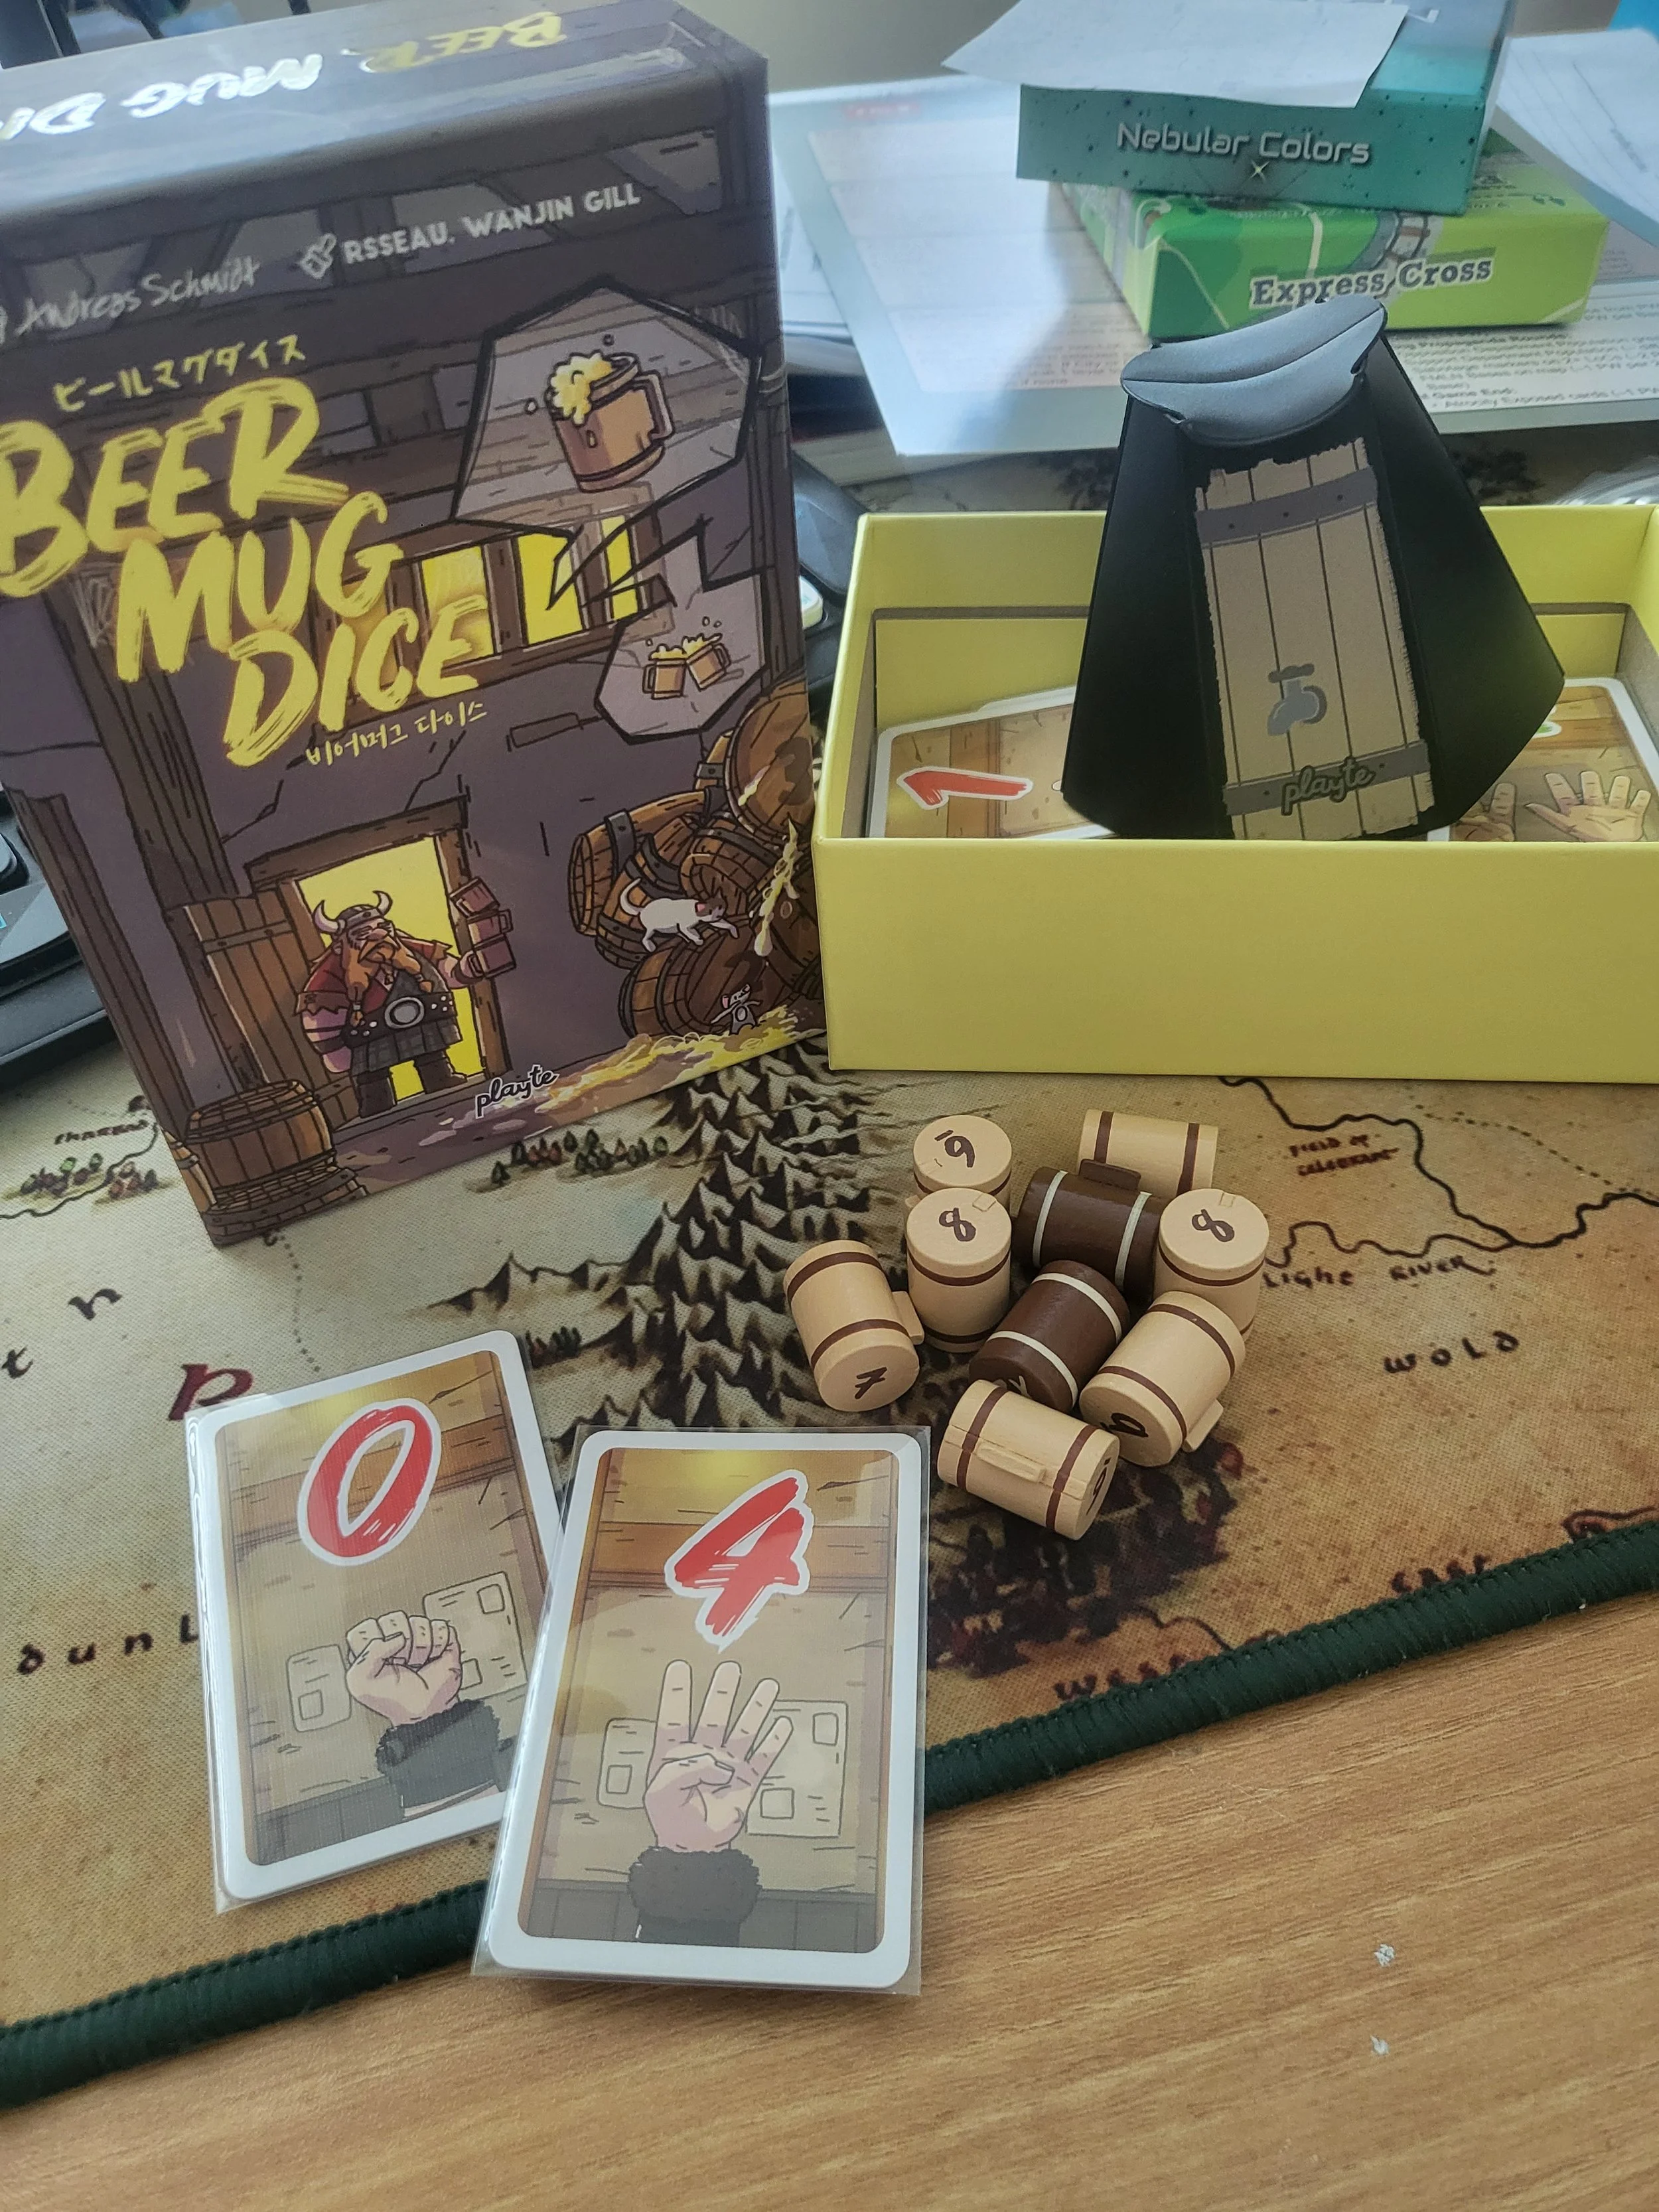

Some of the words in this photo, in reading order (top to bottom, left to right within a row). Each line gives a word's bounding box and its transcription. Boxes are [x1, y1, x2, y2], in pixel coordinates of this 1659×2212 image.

[341, 11, 568, 74] BEER
[119, 53, 324, 119] MUG
[0, 92, 107, 141] DI
[1116, 121, 1251, 157] Nebular
[1258, 130, 1370, 165] Colors
[461, 196, 575, 239] WANJIN
[583, 183, 642, 214] GILL
[1252, 272, 1386, 307] Express
[1398, 259, 1492, 289] Cross
[0, 376, 350, 597] BEER
[115, 491, 403, 682] MUG
[223, 595, 487, 767] DICE
[1281, 757, 1376, 815] playte
[475, 1065, 557, 1118] playte
[938, 1207, 977, 1242] 8
[1190, 1208, 1236, 1243] 8
[664, 1469, 815, 1654] 4
